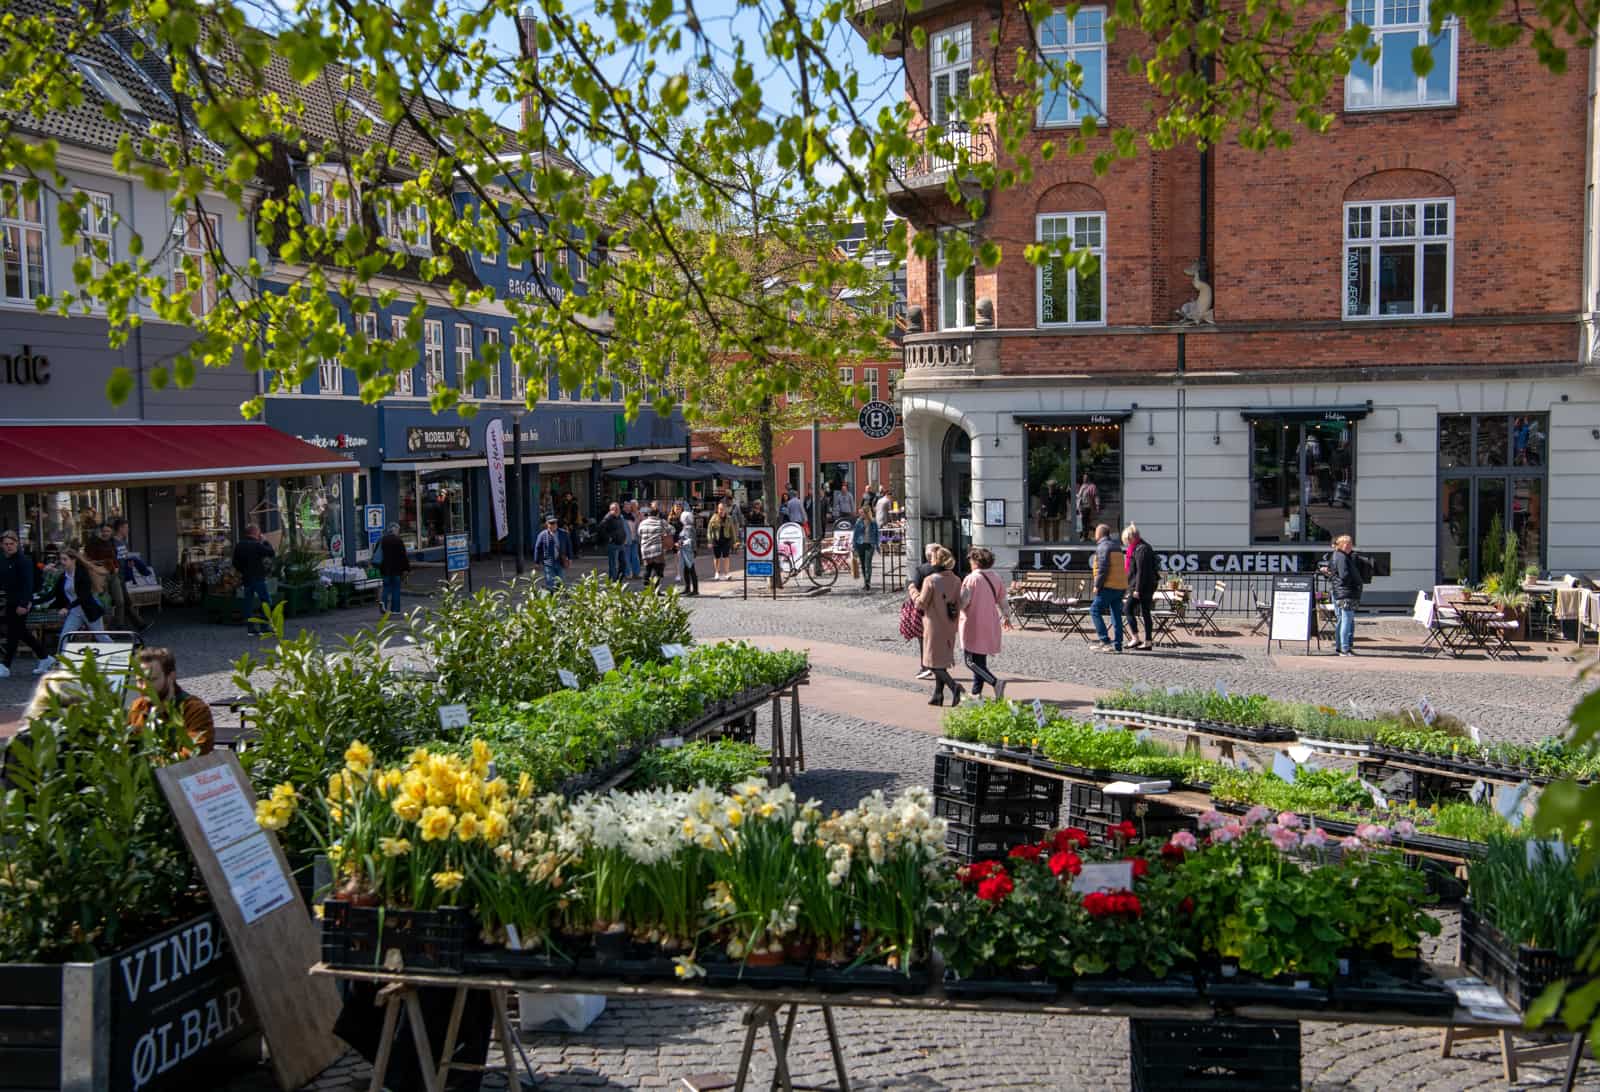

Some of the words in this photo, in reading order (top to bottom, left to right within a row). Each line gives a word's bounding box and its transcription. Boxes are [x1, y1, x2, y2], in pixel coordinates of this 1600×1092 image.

[1044, 260, 1054, 320] ANDLÆGE
[1209, 551, 1298, 573] CAFÉEN
[132, 986, 244, 1092] ØLBAR
